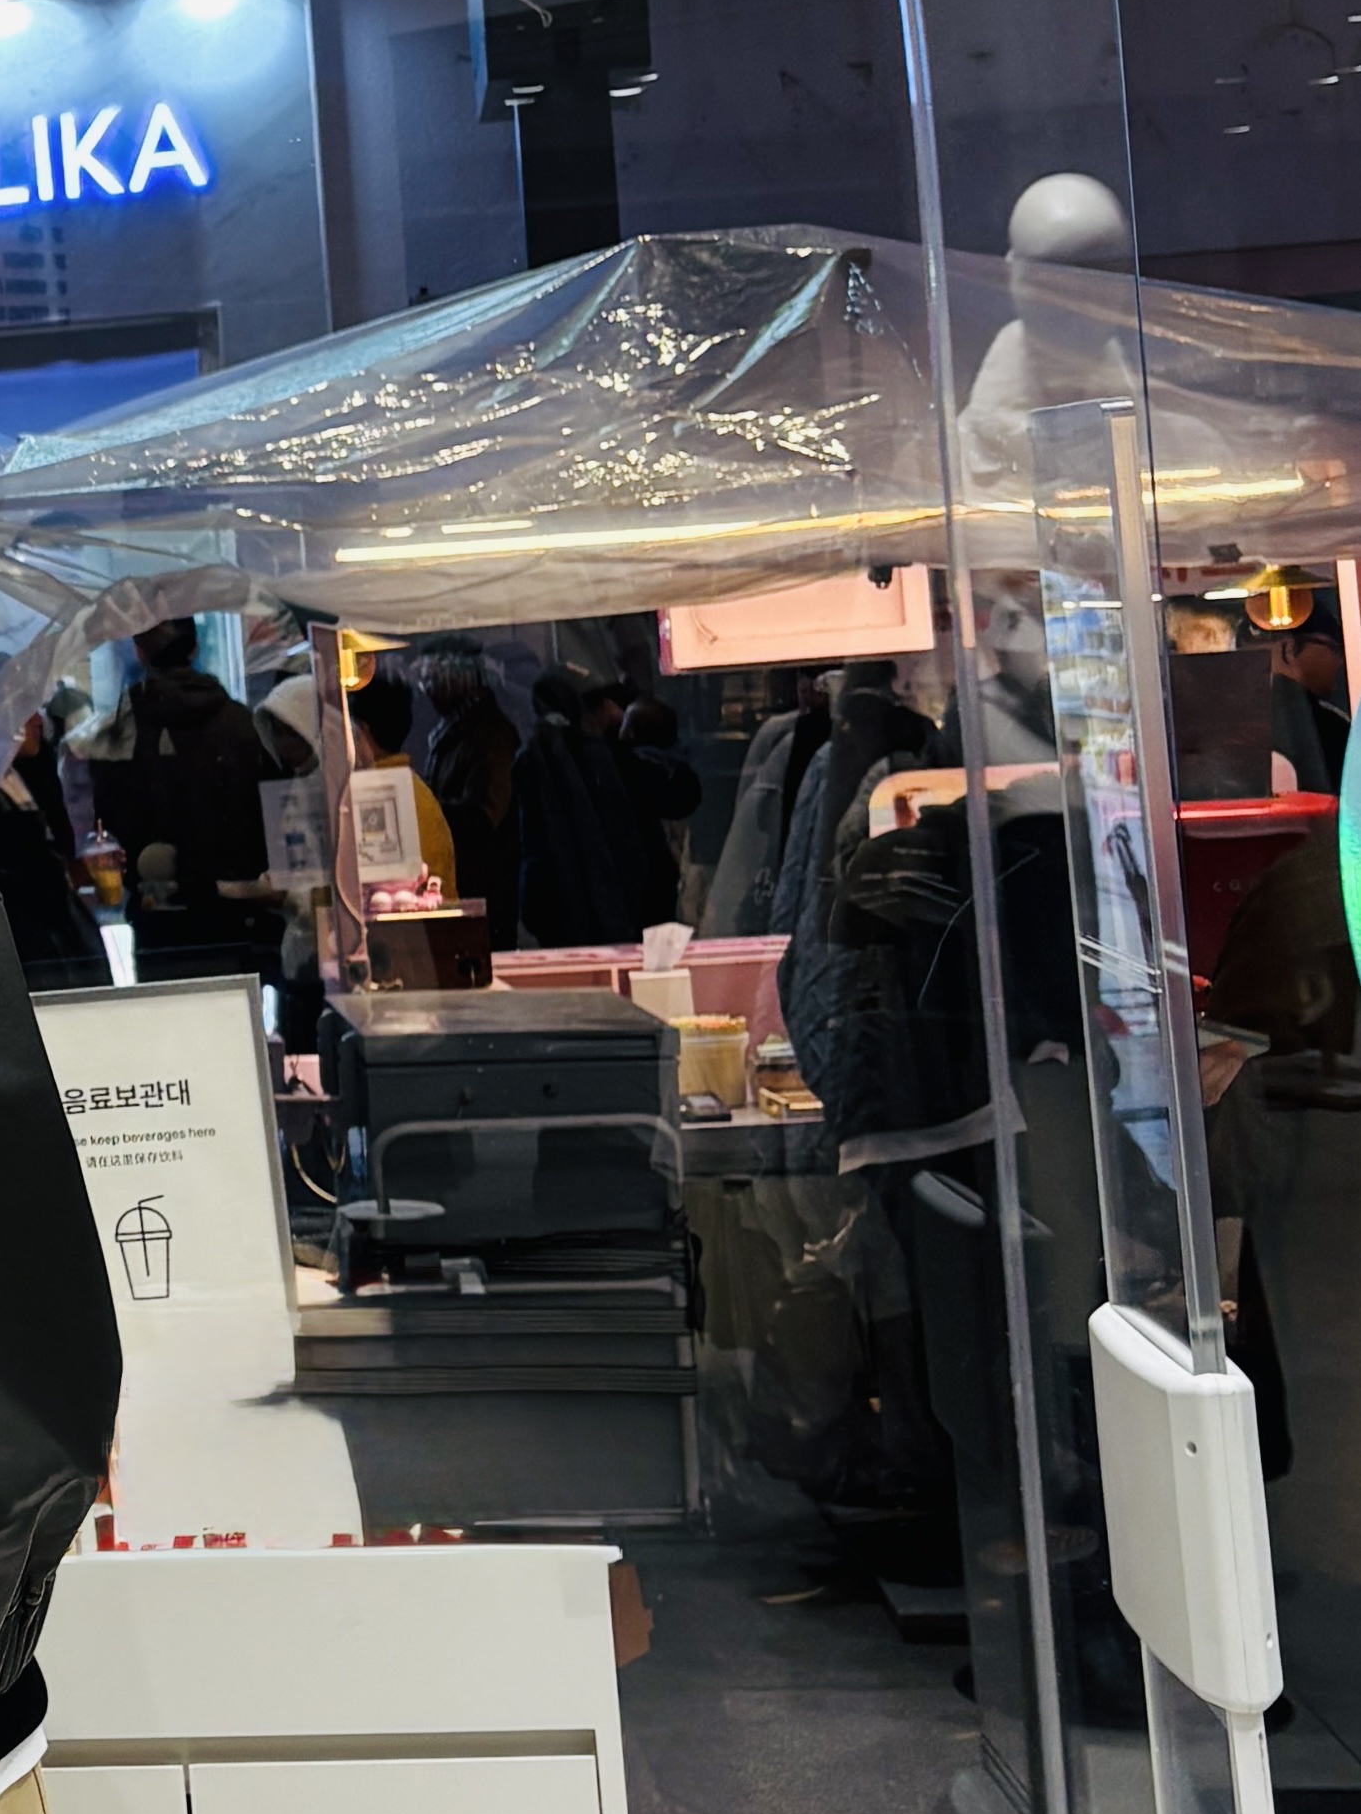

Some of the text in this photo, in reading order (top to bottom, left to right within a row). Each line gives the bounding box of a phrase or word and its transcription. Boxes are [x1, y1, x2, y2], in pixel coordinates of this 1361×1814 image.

[62, 1079, 191, 1115] 음료보관대
[90, 1134, 120, 1147] keep
[122, 1129, 187, 1145] beverages
[188, 1127, 217, 1139] here
